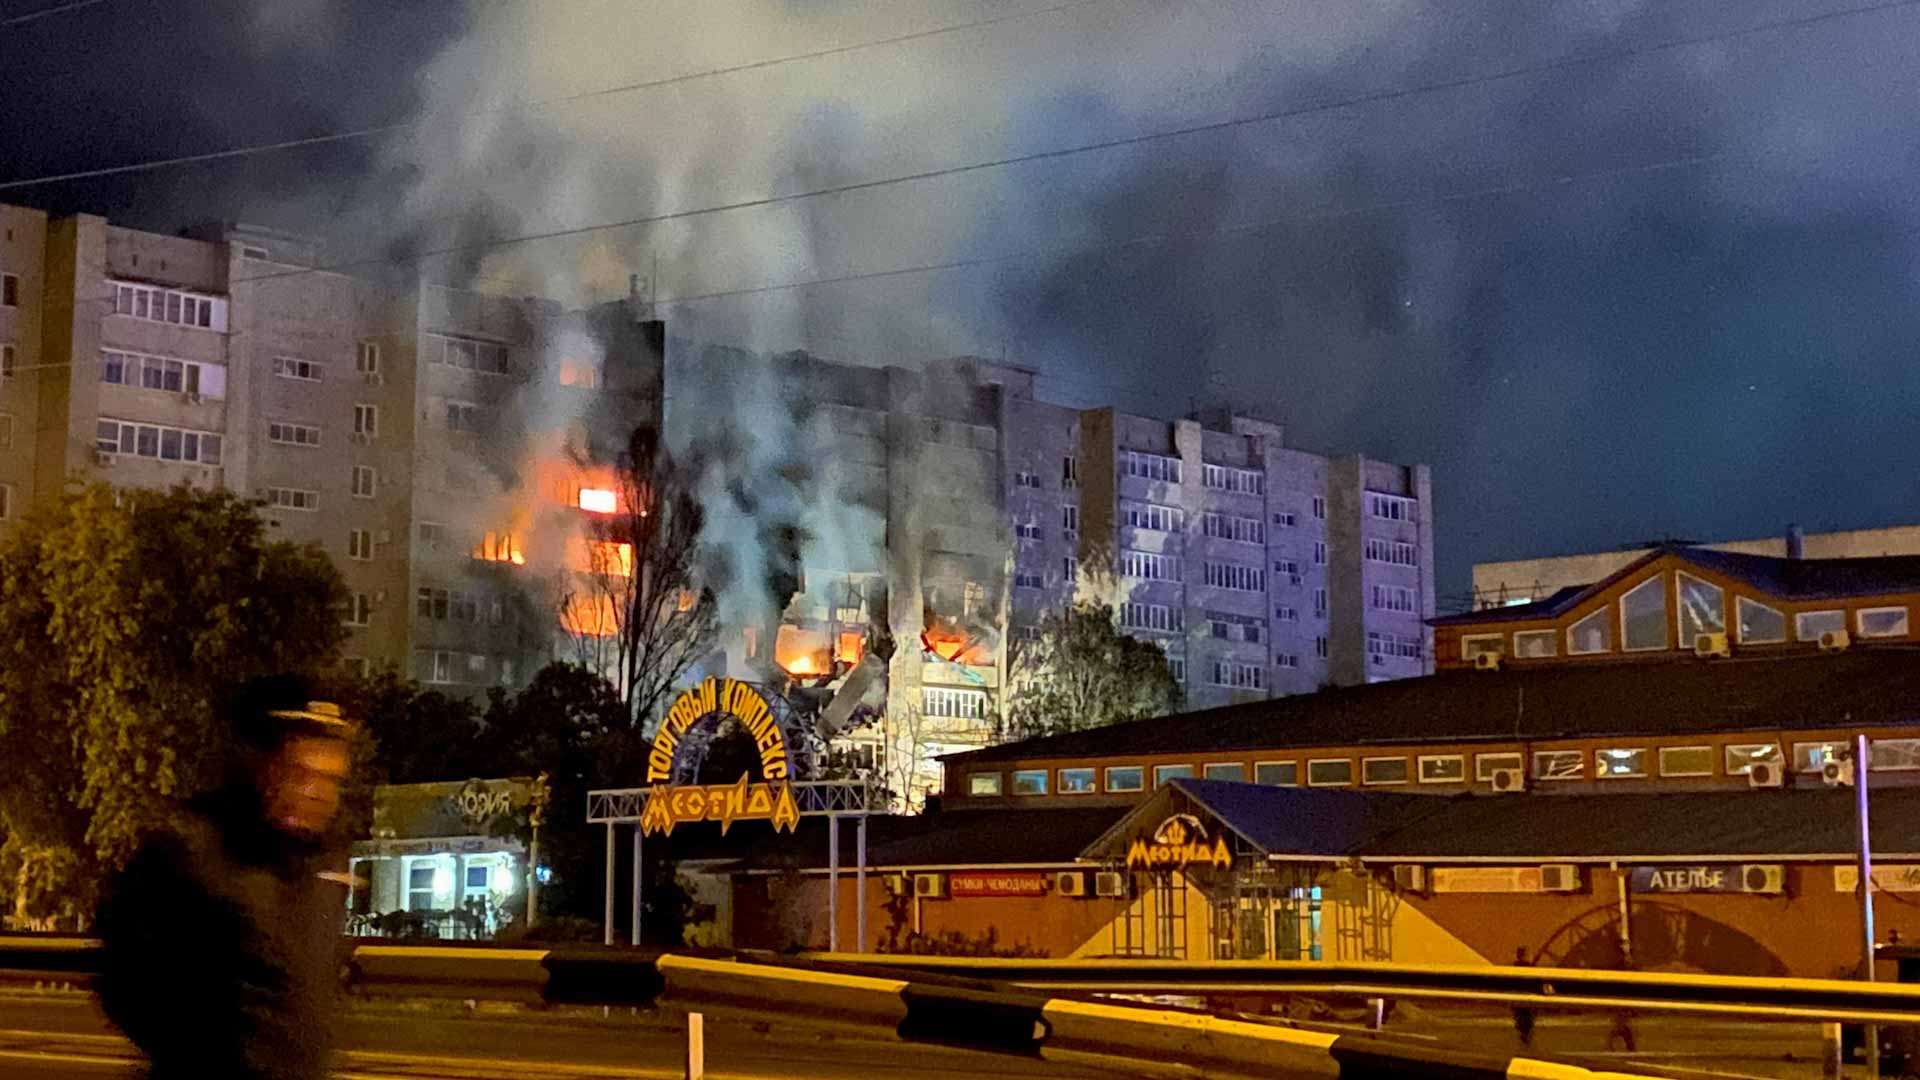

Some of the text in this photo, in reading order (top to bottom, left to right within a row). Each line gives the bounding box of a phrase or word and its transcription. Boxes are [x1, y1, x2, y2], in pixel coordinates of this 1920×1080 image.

[647, 674, 788, 783] ТОРГОВЫЙ КОМПЛЕКС
[1650, 867, 1725, 889] АТЕЛЬЕ
